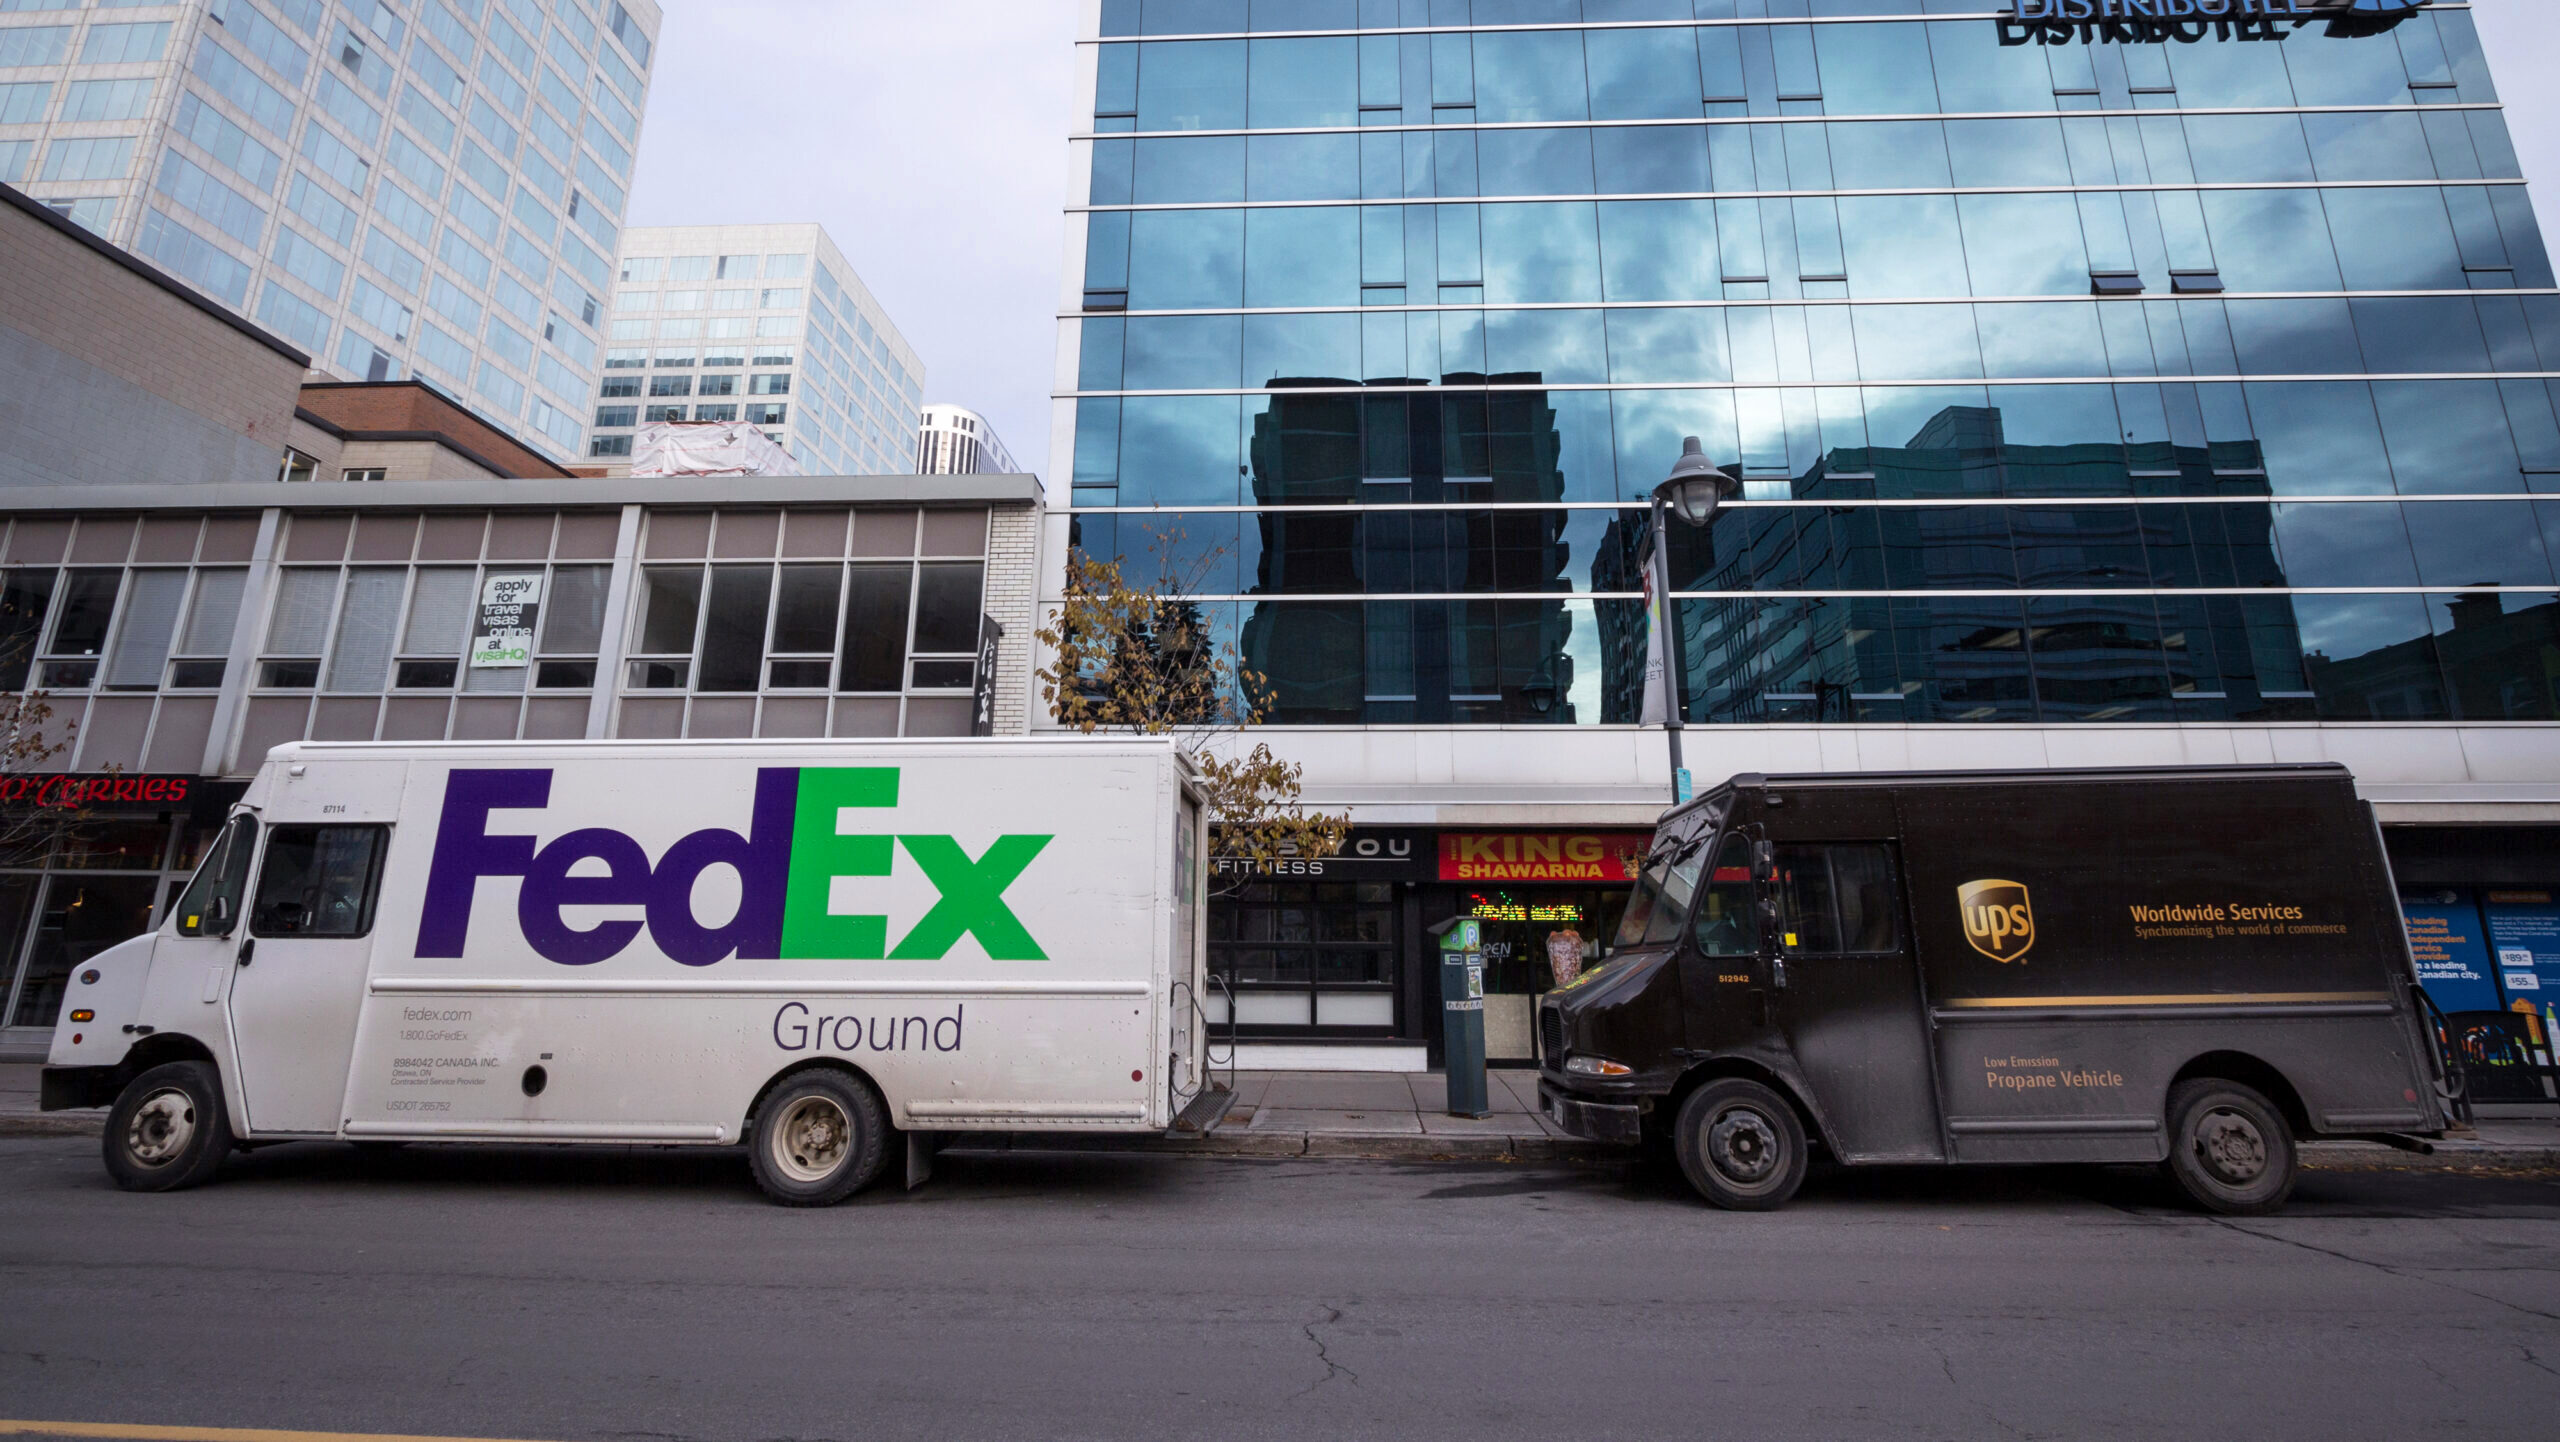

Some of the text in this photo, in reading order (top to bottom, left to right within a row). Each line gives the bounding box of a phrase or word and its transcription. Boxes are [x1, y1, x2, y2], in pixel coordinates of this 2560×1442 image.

[494, 579, 533, 593] apply
[495, 593, 516, 603] for
[484, 603, 524, 615] travel
[482, 615, 520, 626] visas
[489, 625, 532, 637] online
[488, 638, 502, 650] at
[322, 804, 346, 814] 87114
[1460, 835, 1604, 863] KING
[414, 767, 1055, 966] FedEx
[1458, 864, 1604, 878] SHAWARMA
[2129, 902, 2303, 922] Worldwide Services
[1966, 904, 2030, 950] ups
[2134, 923, 2348, 939] Synchronizing the world of commerce
[1480, 942, 1511, 955] PEN
[2432, 960, 2467, 972] leading
[1719, 974, 1750, 983] 512942
[2460, 970, 2482, 980] city.
[403, 1006, 472, 1021] fedex.com
[773, 1001, 963, 1053] Ground
[400, 1030, 469, 1041] 1.800.GoFedEx
[394, 1058, 501, 1067] 8984042 CANADA INC.
[1984, 1055, 2060, 1068] Low Emission
[419, 1069, 431, 1077] ON
[391, 1077, 486, 1086] Contracted Service Provider
[1987, 1069, 2124, 1093] Propane Vehicle
[386, 1101, 417, 1111] USDOT
